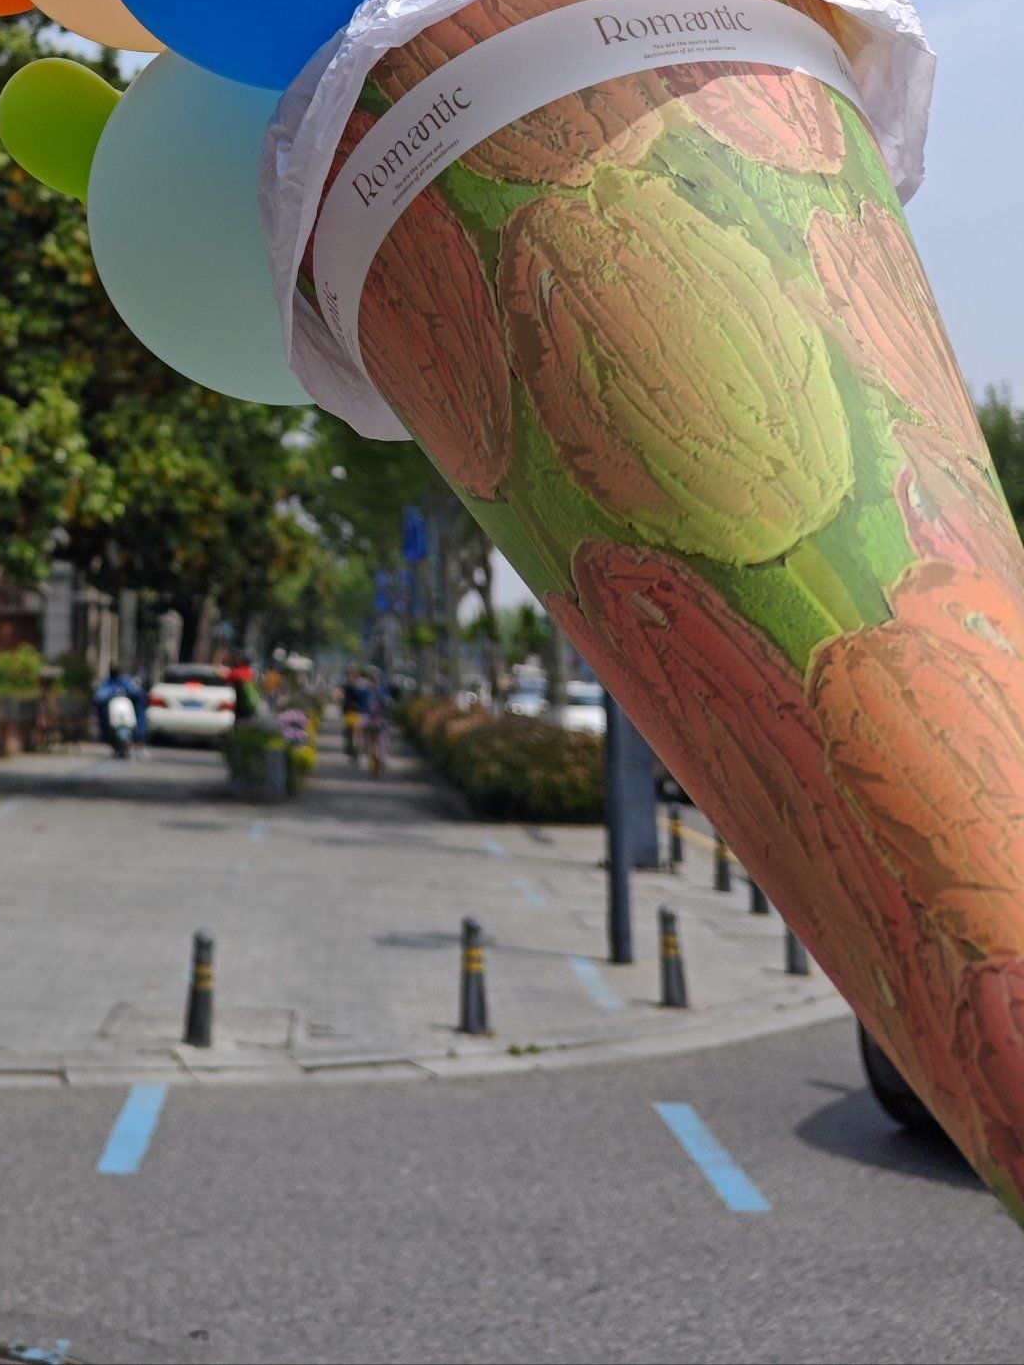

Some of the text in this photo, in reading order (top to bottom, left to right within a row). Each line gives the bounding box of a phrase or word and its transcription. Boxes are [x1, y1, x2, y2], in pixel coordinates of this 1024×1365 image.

[593, 5, 753, 46] Romantic
[688, 38, 707, 46] source
[643, 49, 679, 60] destination
[705, 44, 737, 52] tenderness
[352, 86, 472, 207] Romantic
[418, 151, 433, 167] source
